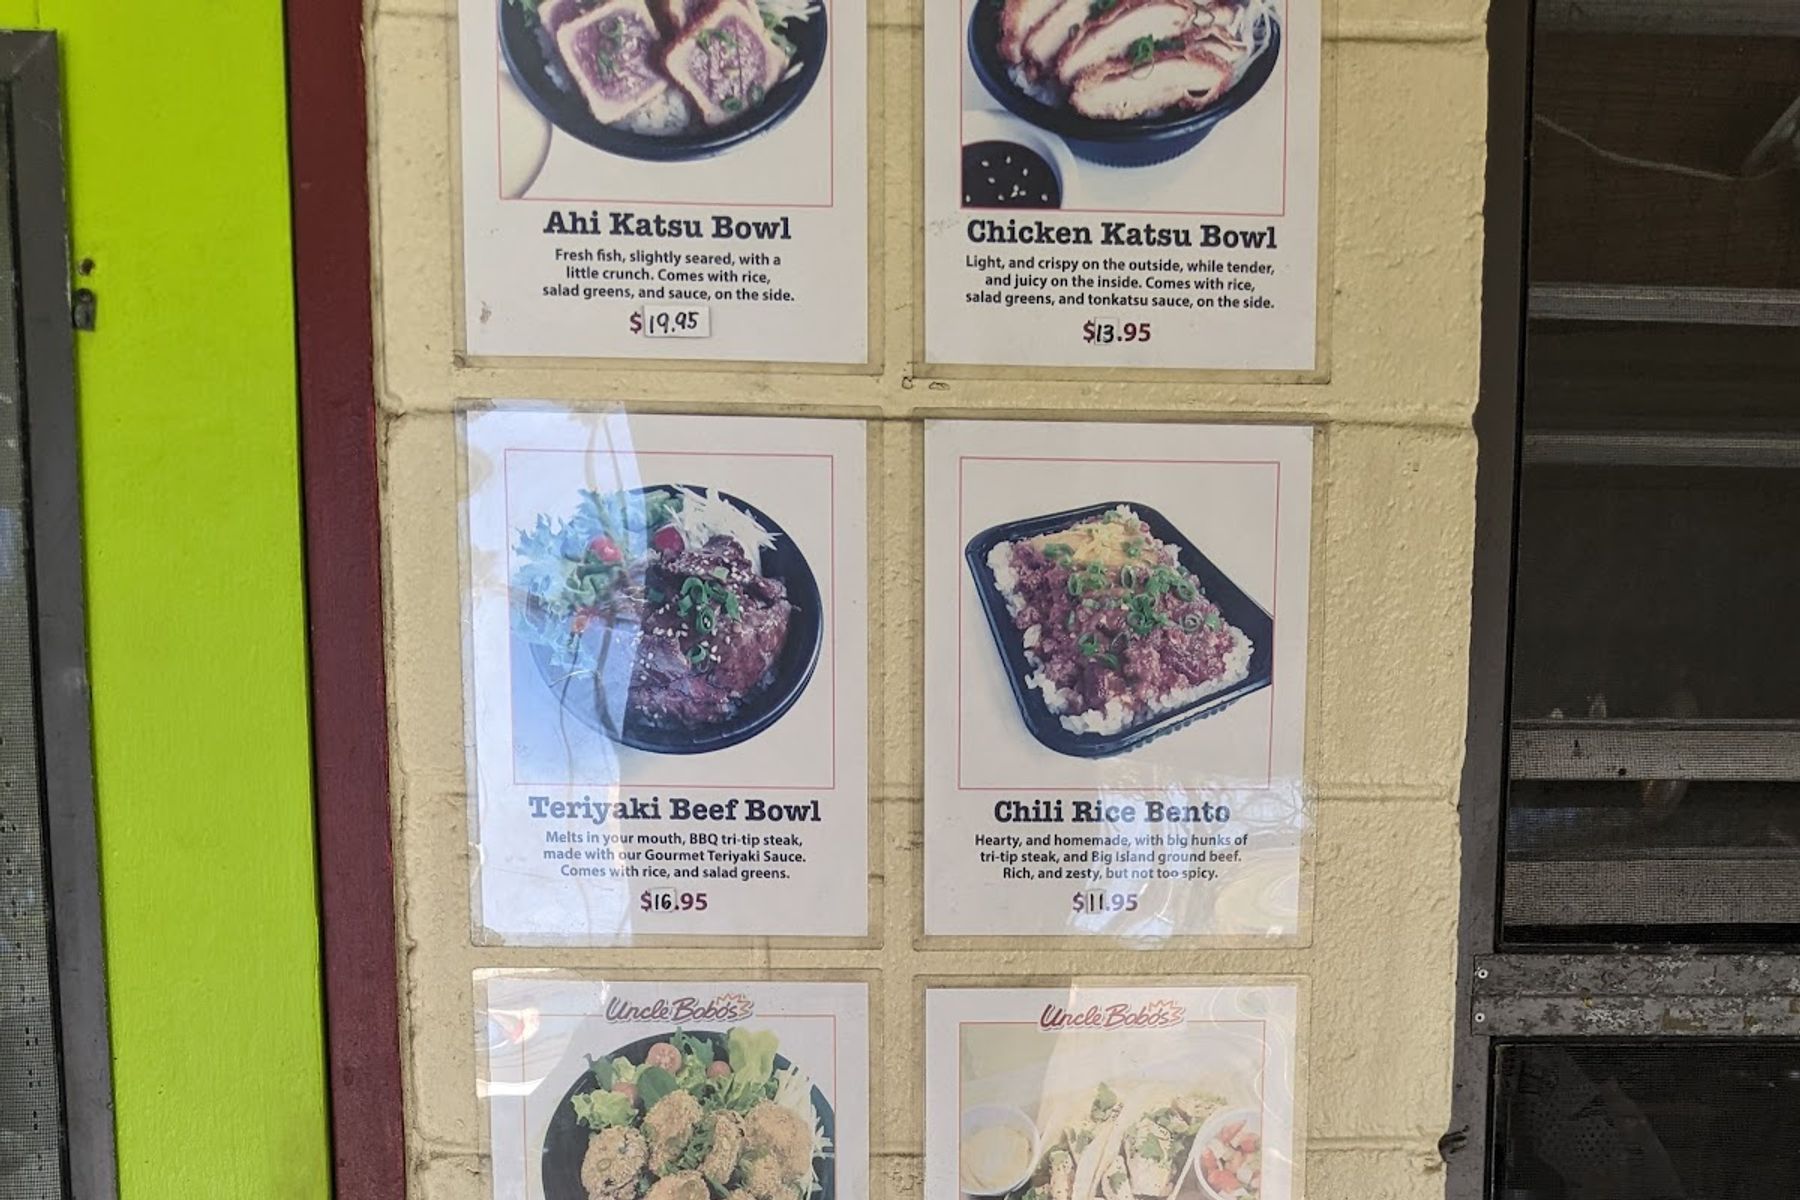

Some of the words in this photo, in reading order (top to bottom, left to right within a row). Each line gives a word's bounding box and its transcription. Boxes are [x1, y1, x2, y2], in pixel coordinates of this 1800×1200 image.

[543, 211, 601, 235] Ahi
[609, 213, 703, 238] Katsu
[712, 216, 791, 240] Bowl
[967, 220, 1092, 245] Chicken
[1101, 222, 1191, 247] Katsu
[1200, 224, 1277, 249] Bowl
[555, 248, 592, 262] Fresh
[596, 249, 625, 263] fish,
[630, 251, 681, 266] slightly
[685, 252, 735, 266] seared,
[739, 254, 769, 265] with
[773, 256, 780, 265] a
[966, 255, 1005, 270] Light,
[1009, 256, 1034, 269] and
[1038, 257, 1078, 272] crispy
[1082, 260, 1099, 270] on
[1103, 258, 1125, 271] the
[1129, 260, 1183, 272] outside,
[1187, 260, 1223, 273] while
[1227, 262, 1275, 275] tender,
[566, 267, 598, 280] little
[603, 268, 654, 280] crunch.
[658, 269, 703, 282] Comes
[707, 270, 737, 283] with
[742, 271, 770, 284] rice,
[529, 795, 661, 825] Teriyaki
[669, 798, 738, 821] Beef
[745, 800, 821, 822] Bowl
[995, 800, 1064, 822] Chili
[1072, 800, 1135, 823] Rice
[1144, 801, 1230, 823] Bento
[546, 831, 583, 843] Melts
[586, 832, 599, 843] in
[603, 834, 634, 846] your
[637, 833, 686, 845] mouth,
[690, 833, 717, 846] BBQ
[721, 834, 760, 846] tri-tip
[763, 834, 802, 846] steak,
[544, 849, 581, 860] made
[585, 849, 614, 860] with
[618, 850, 641, 860] our
[645, 850, 704, 862] Gourmet
[707, 850, 760, 864] Teriyaki
[764, 851, 806, 862] Sauce.
[981, 851, 1018, 864] tri-tip
[1021, 851, 1060, 864] steak,
[1063, 851, 1088, 863] and
[1092, 851, 1111, 865] Big
[1115, 851, 1155, 863] Island
[1158, 851, 1205, 865] ground
[1209, 851, 1241, 863] beef.
[606, 998, 670, 1022] Uncle
[1041, 1003, 1102, 1028] Uncle
